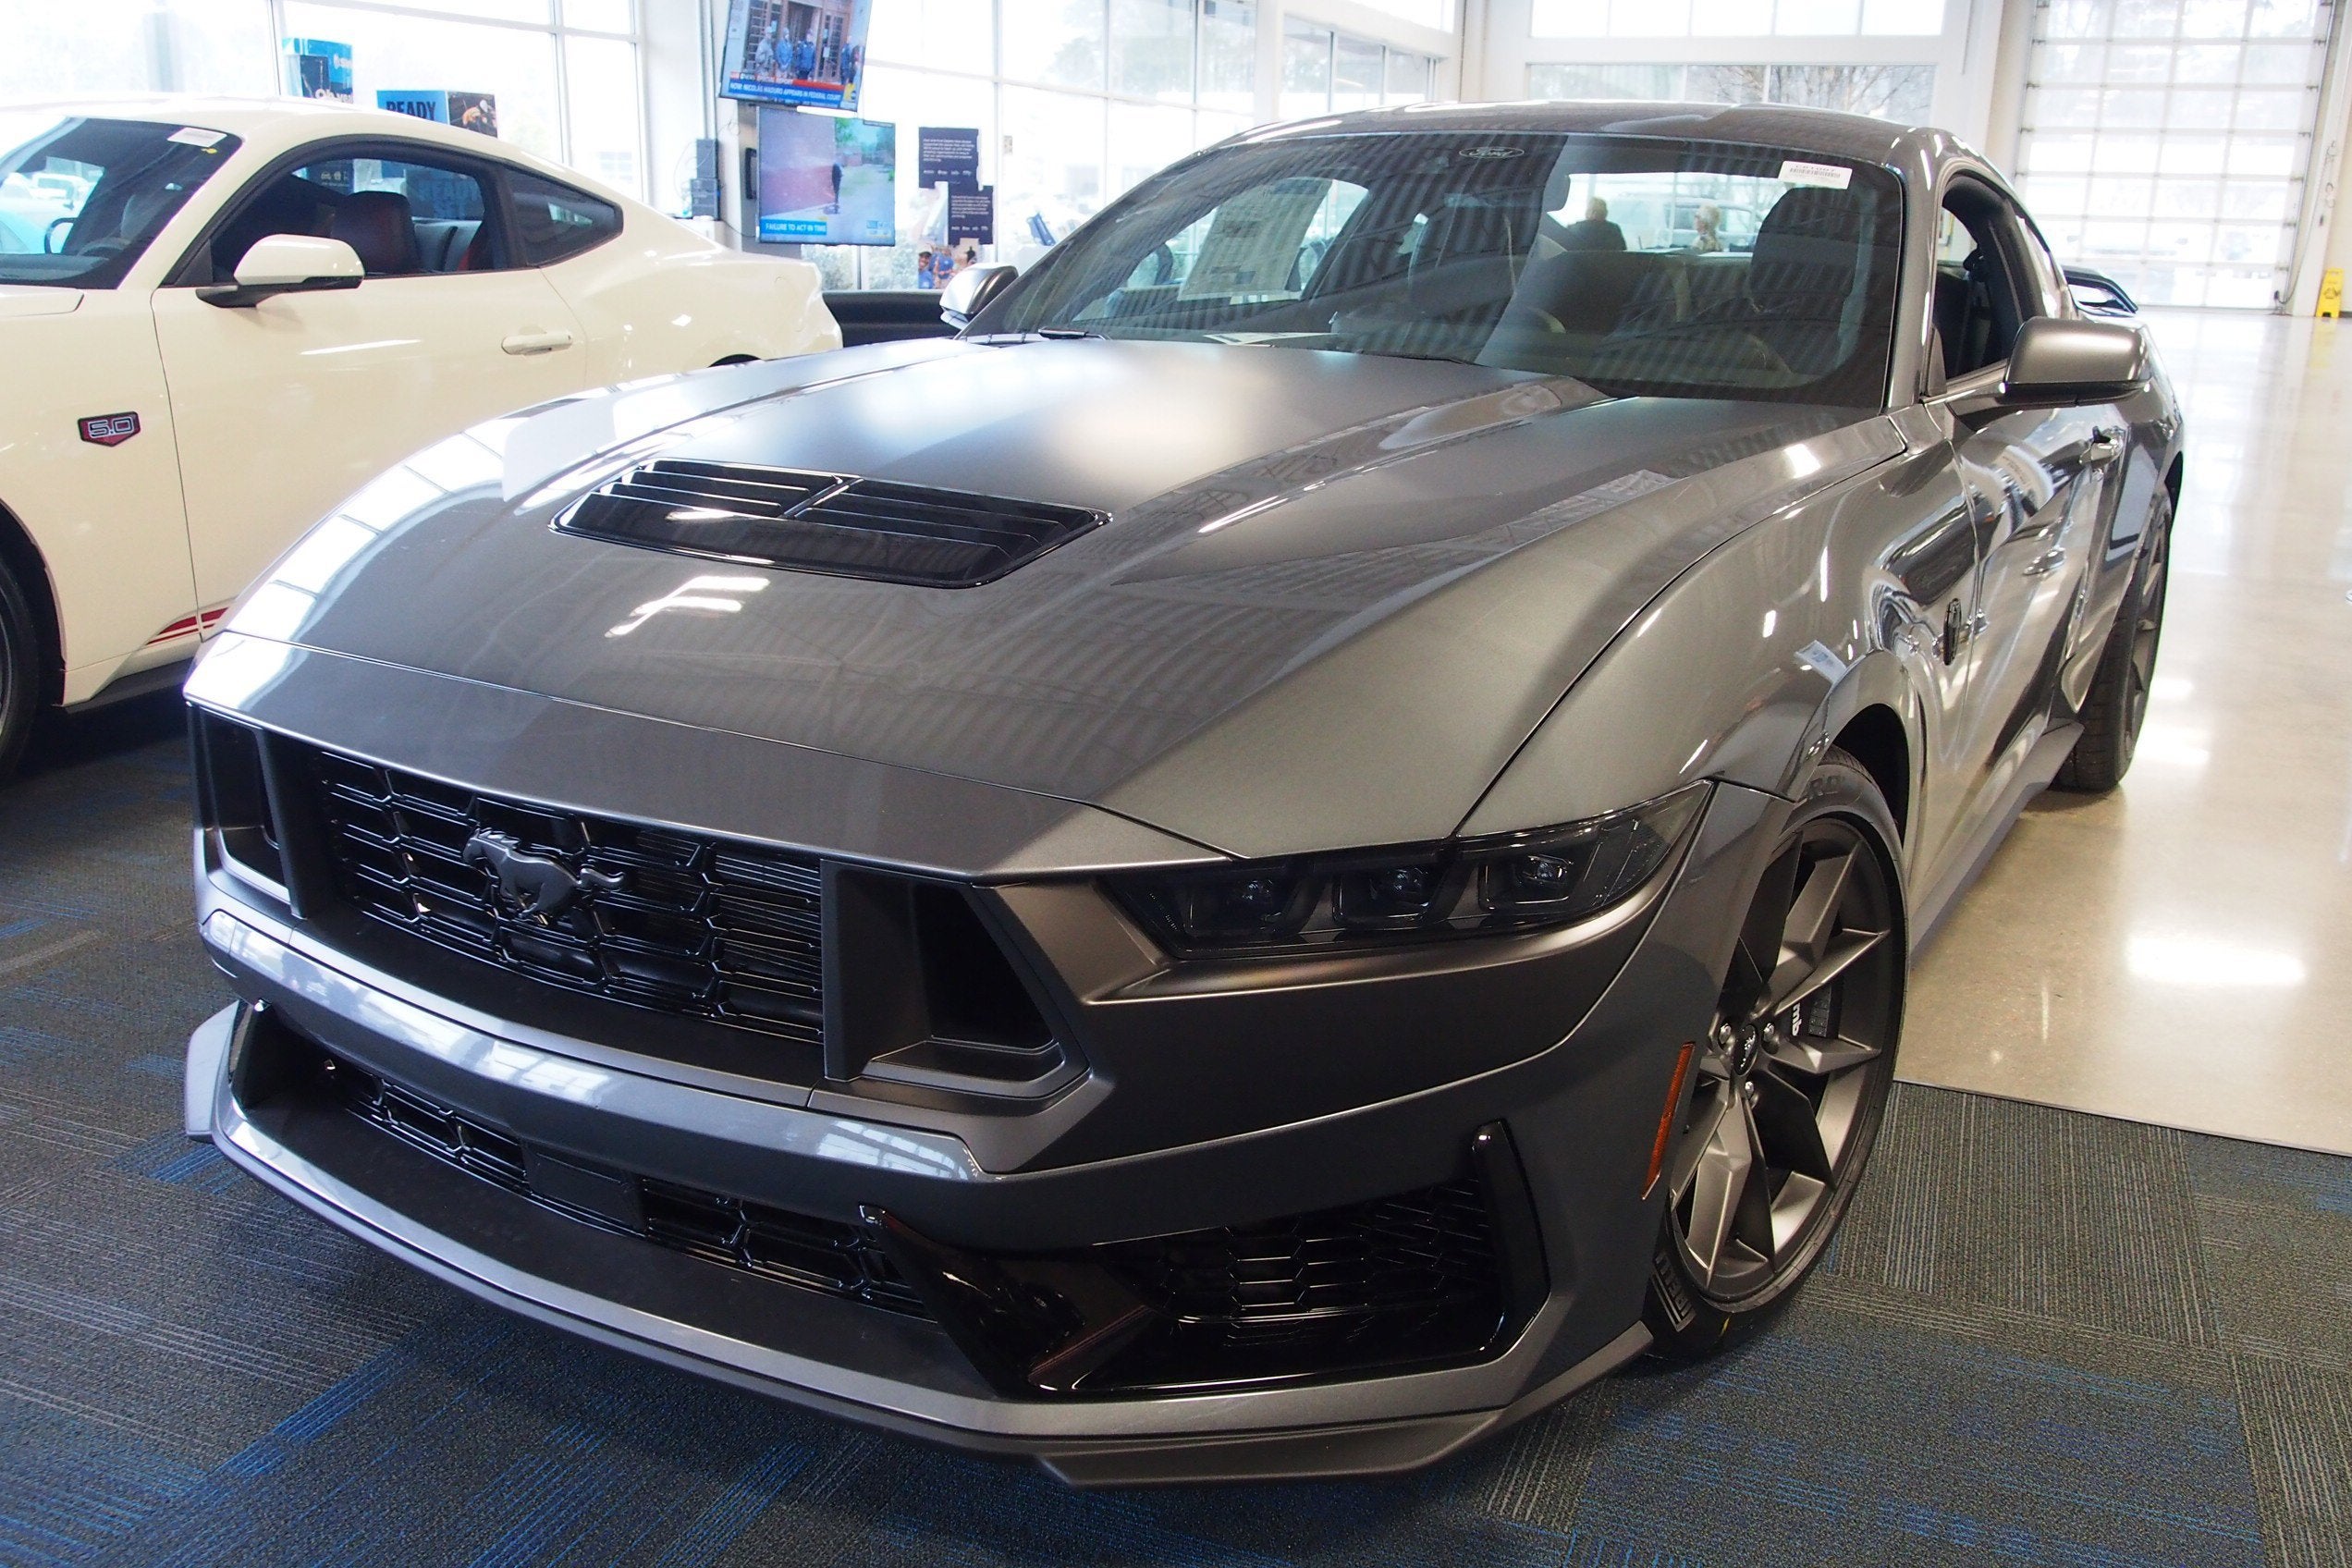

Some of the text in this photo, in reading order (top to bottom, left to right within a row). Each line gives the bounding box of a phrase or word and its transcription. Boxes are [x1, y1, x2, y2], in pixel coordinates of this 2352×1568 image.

[765, 222, 787, 230] FAILURE
[814, 224, 827, 232] TIME
[88, 416, 135, 439] 5.0
